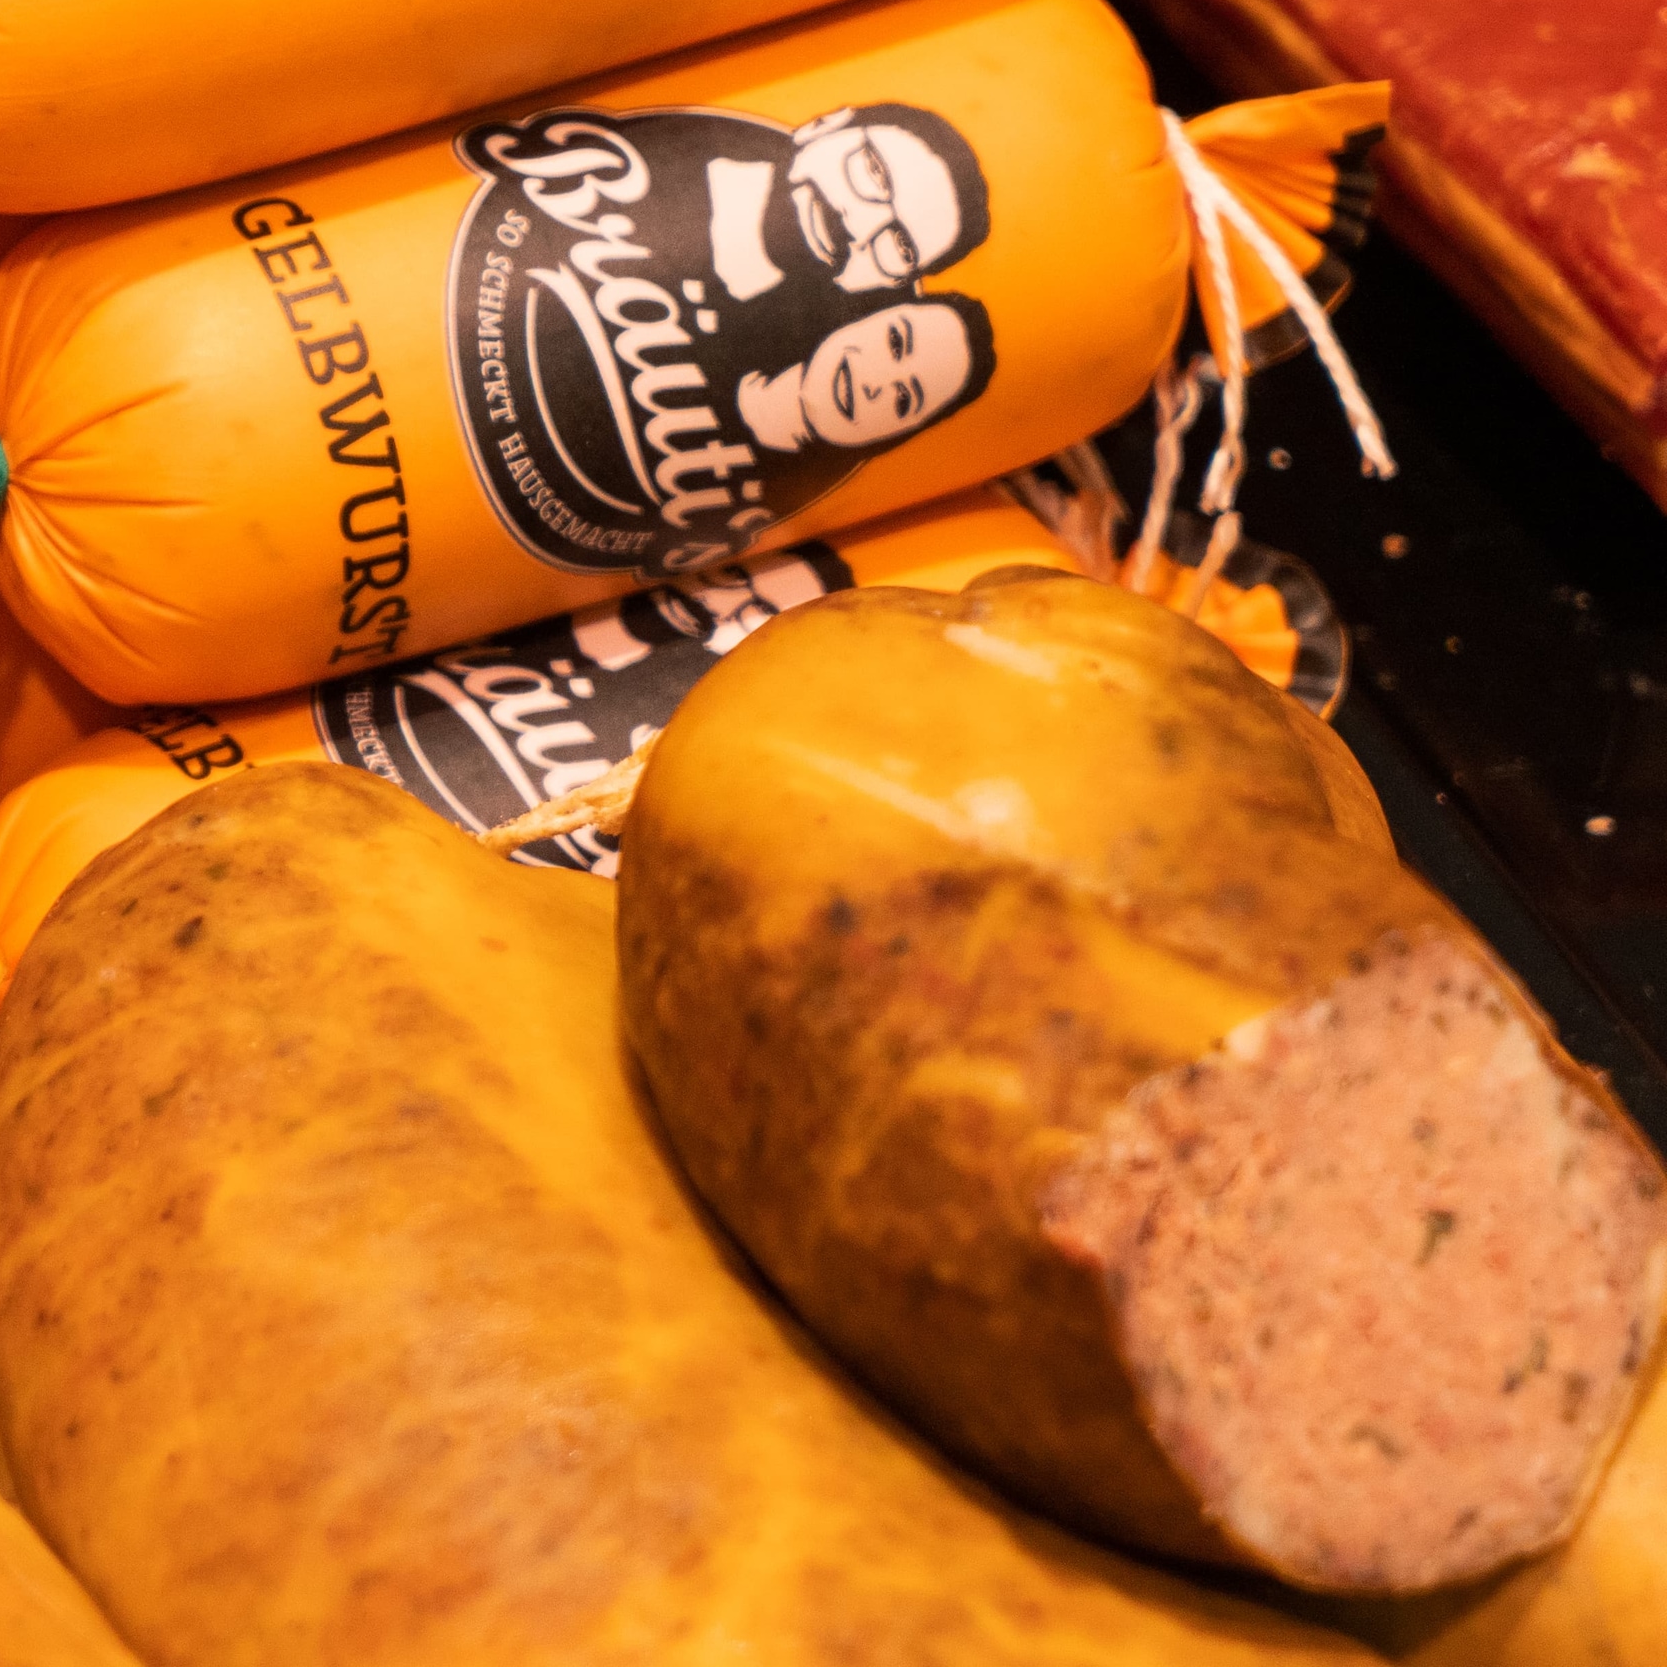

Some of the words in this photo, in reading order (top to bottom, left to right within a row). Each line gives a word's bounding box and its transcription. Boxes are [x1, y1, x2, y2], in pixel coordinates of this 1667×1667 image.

[496, 208, 531, 249] SO
[477, 250, 518, 425] SCHMECKT
[231, 196, 412, 665] GELBWURST
[498, 431, 657, 555] HAUSGEMACHT
